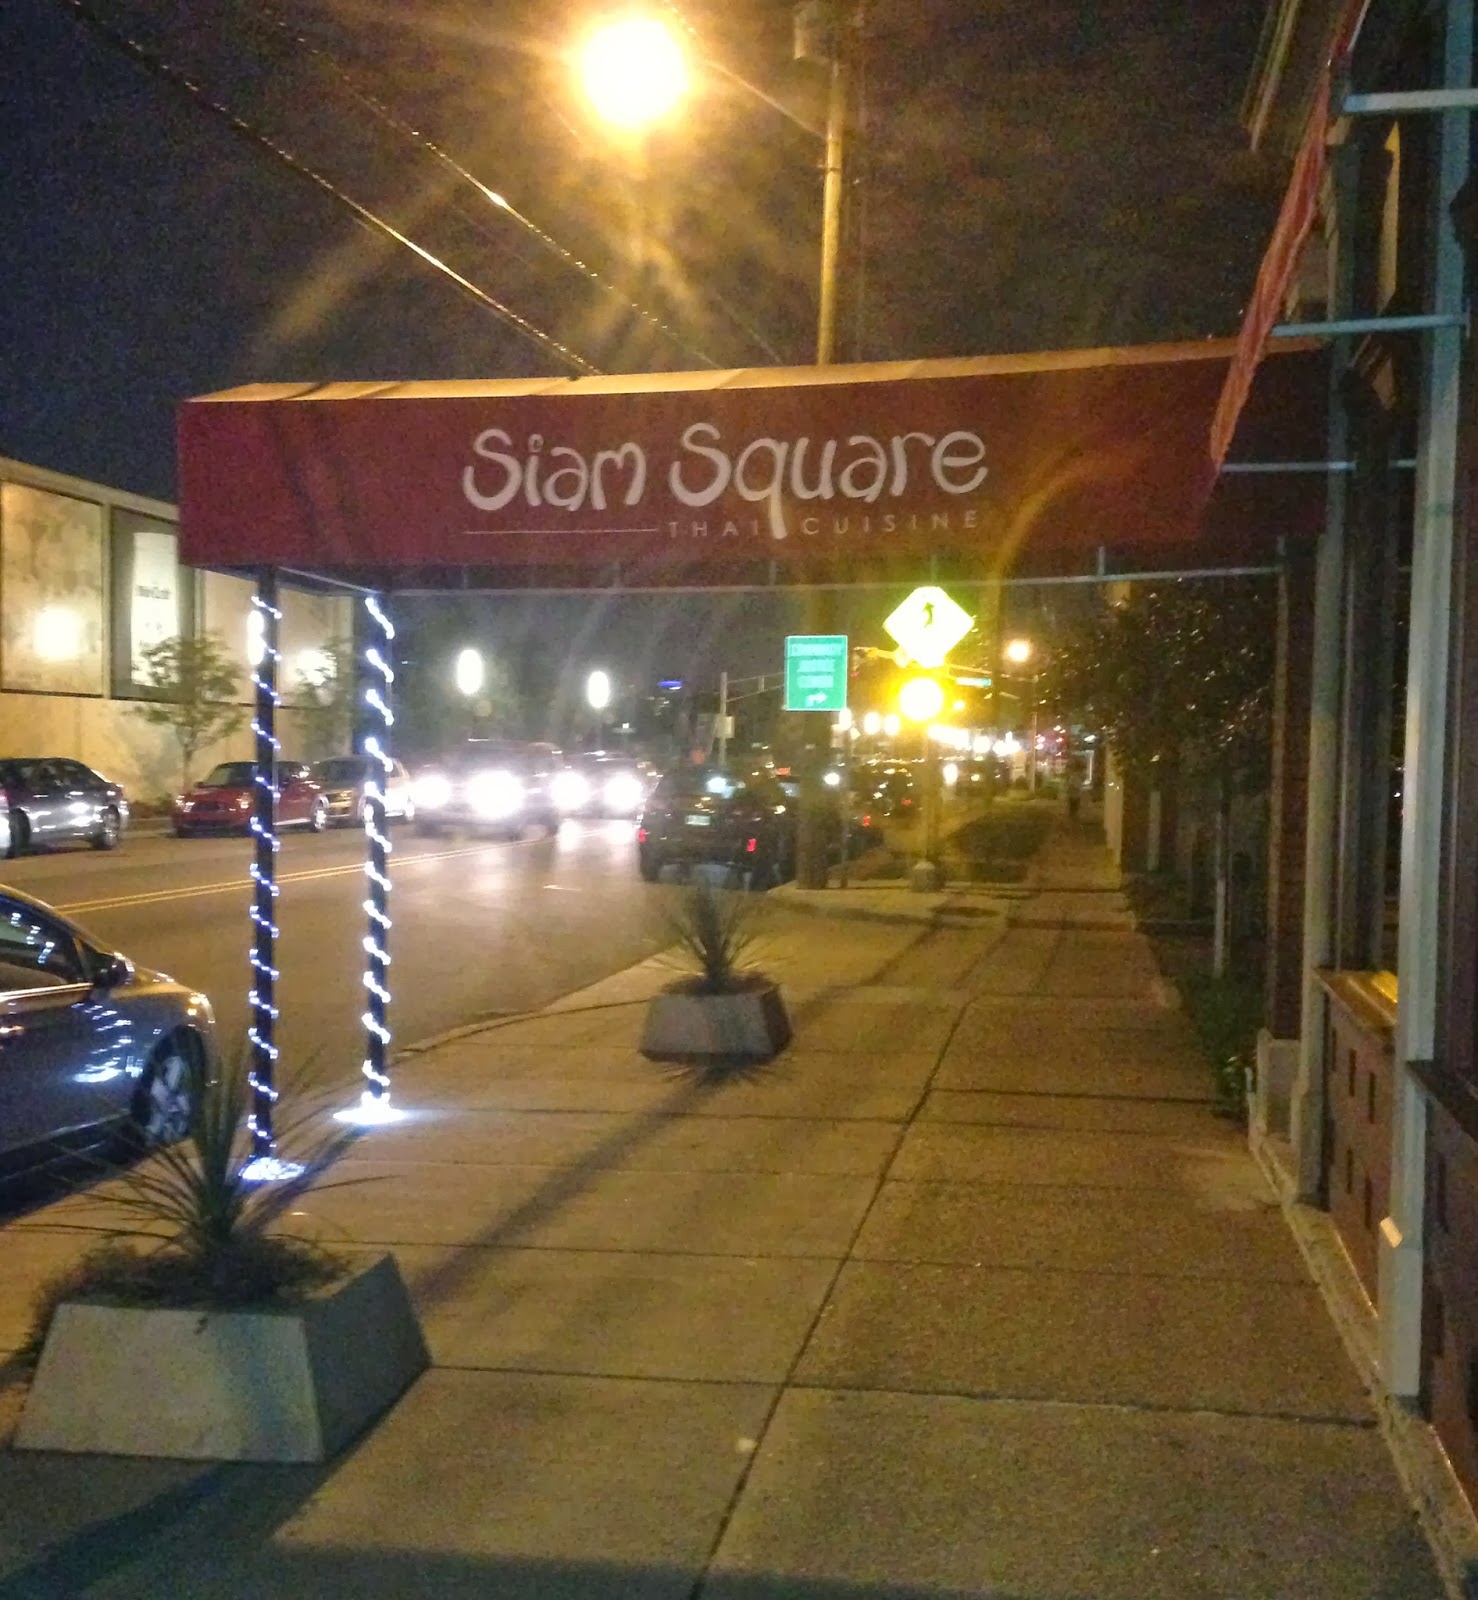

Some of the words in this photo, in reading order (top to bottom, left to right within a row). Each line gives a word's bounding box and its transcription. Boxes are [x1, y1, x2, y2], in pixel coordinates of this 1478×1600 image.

[462, 428, 648, 511] Siam
[669, 422, 989, 539] Square
[668, 519, 759, 538] THAI
[801, 509, 978, 536] CUISINE
